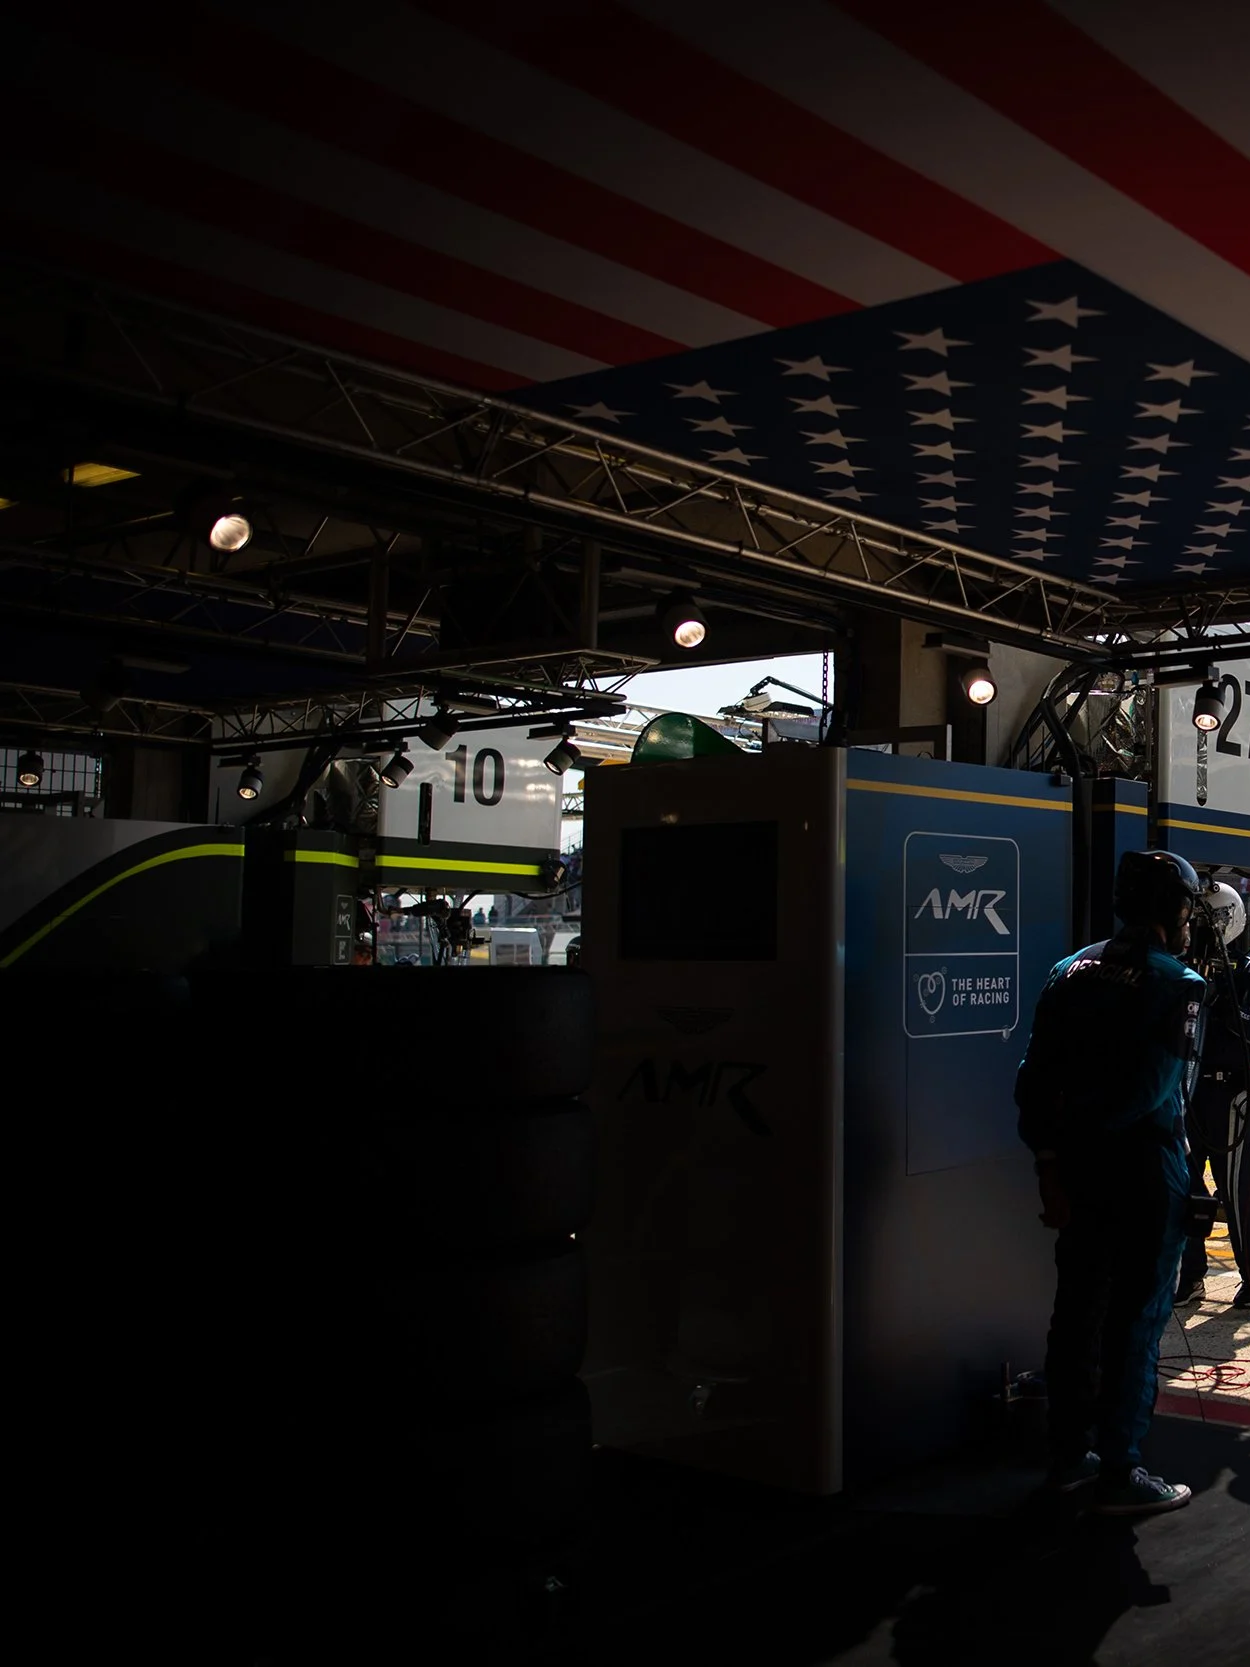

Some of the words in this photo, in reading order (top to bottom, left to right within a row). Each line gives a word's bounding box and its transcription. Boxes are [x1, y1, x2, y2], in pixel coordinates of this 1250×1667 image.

[445, 744, 505, 806] 10
[913, 887, 1011, 935] AMR
[951, 977, 973, 991] THE
[976, 976, 1012, 991] HEART
[952, 993, 967, 1007] OF
[970, 991, 1010, 1006] RACING
